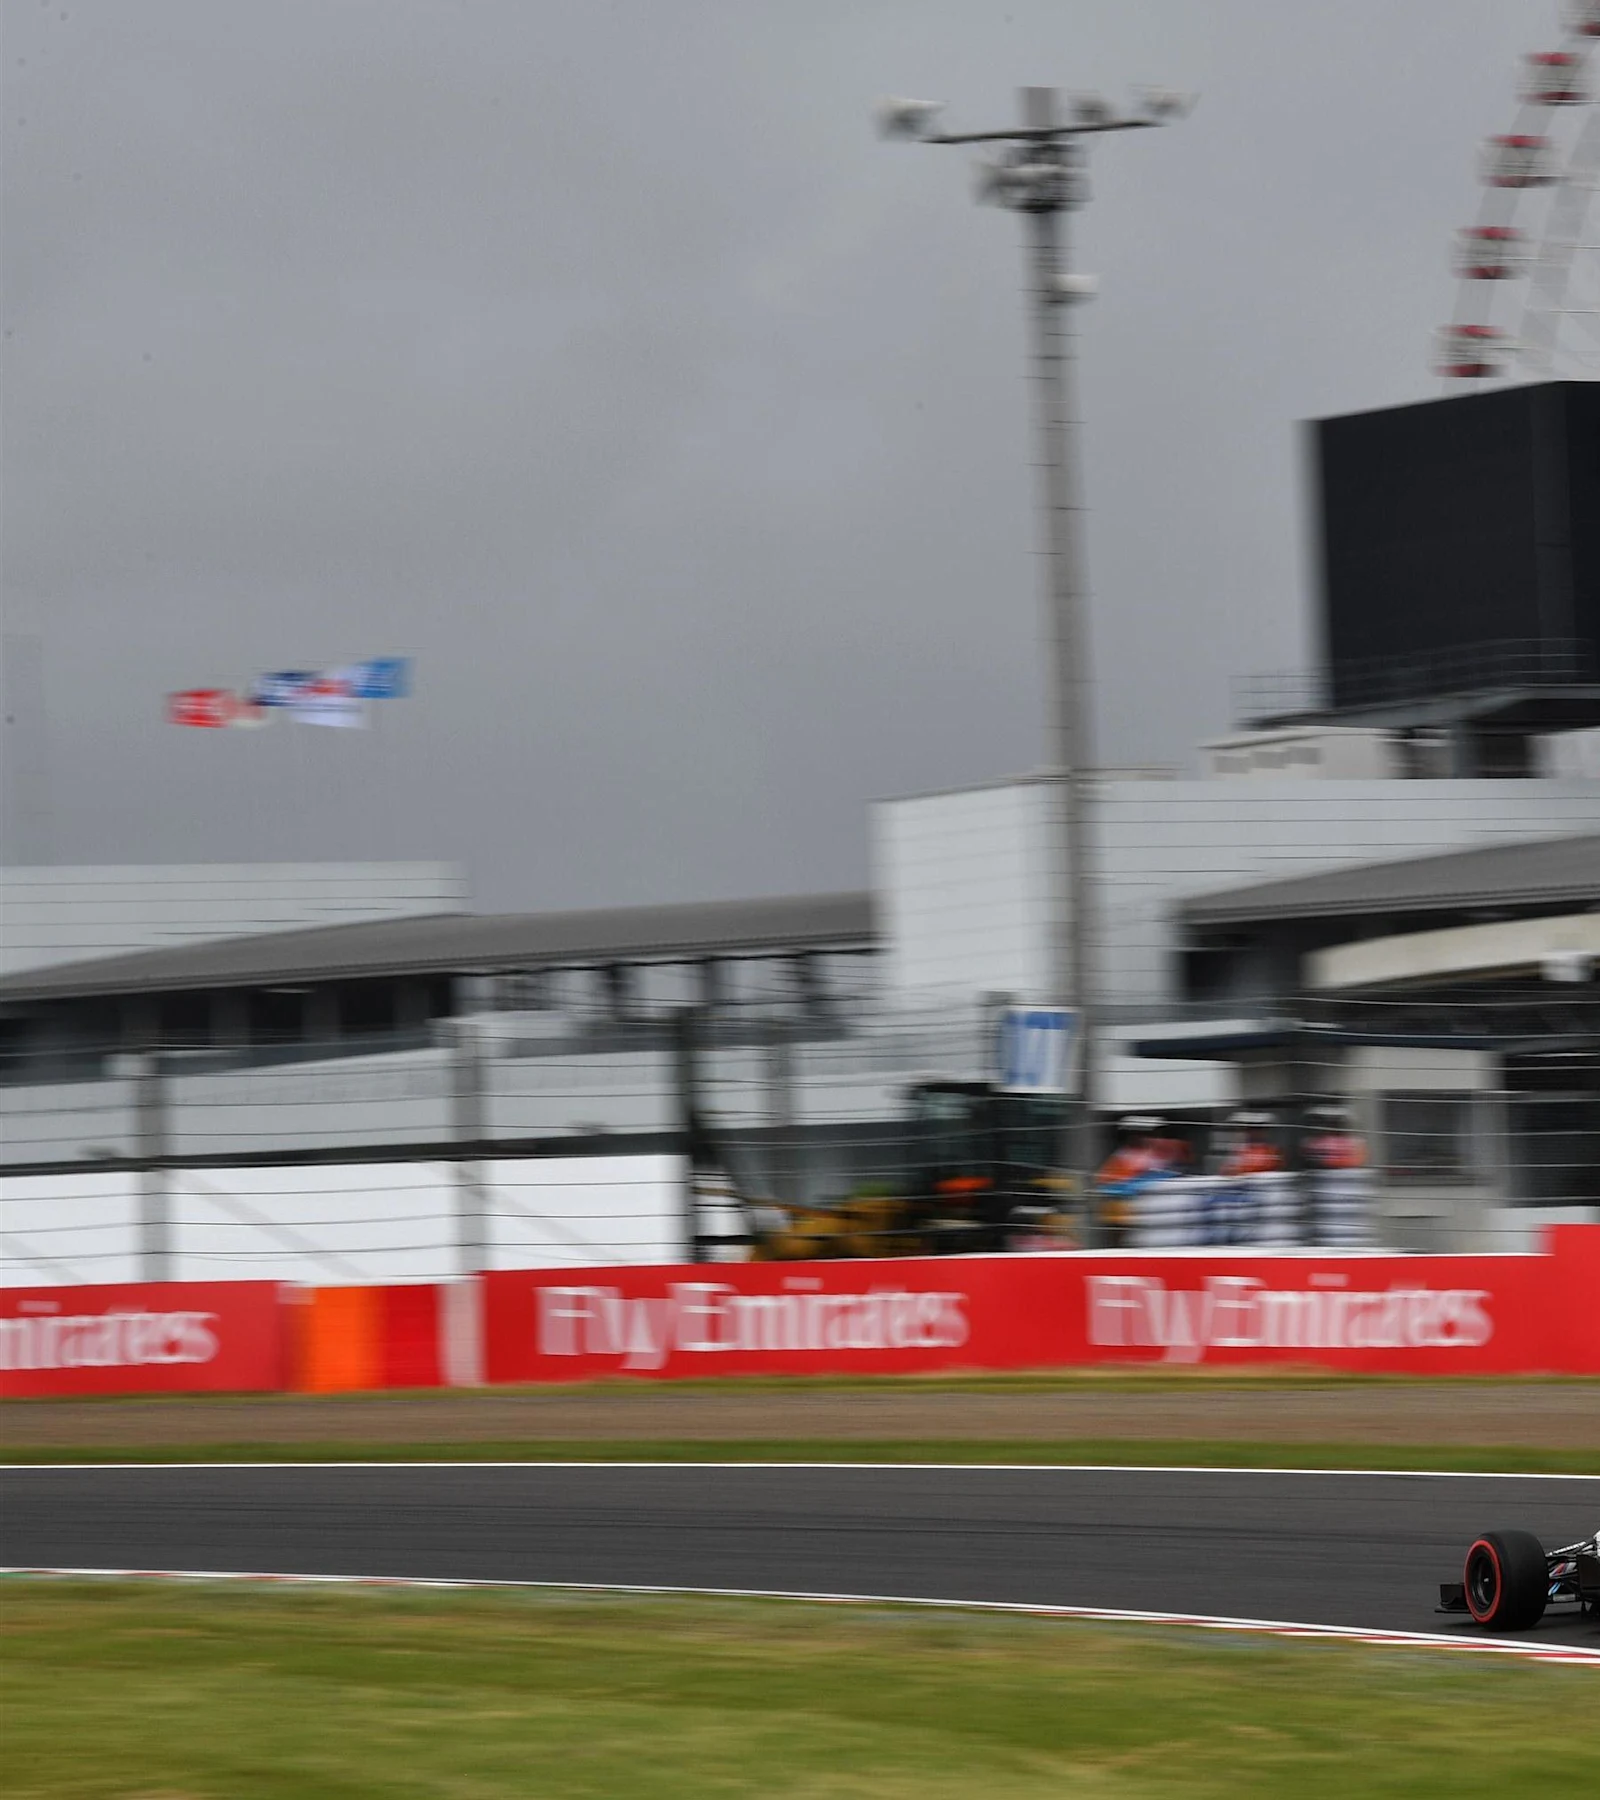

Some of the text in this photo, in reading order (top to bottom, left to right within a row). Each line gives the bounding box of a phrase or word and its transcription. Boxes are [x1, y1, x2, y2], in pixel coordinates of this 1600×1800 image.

[535, 1276, 969, 1370] Fly Emirates
[1086, 1272, 1494, 1363] Fly Emirates
